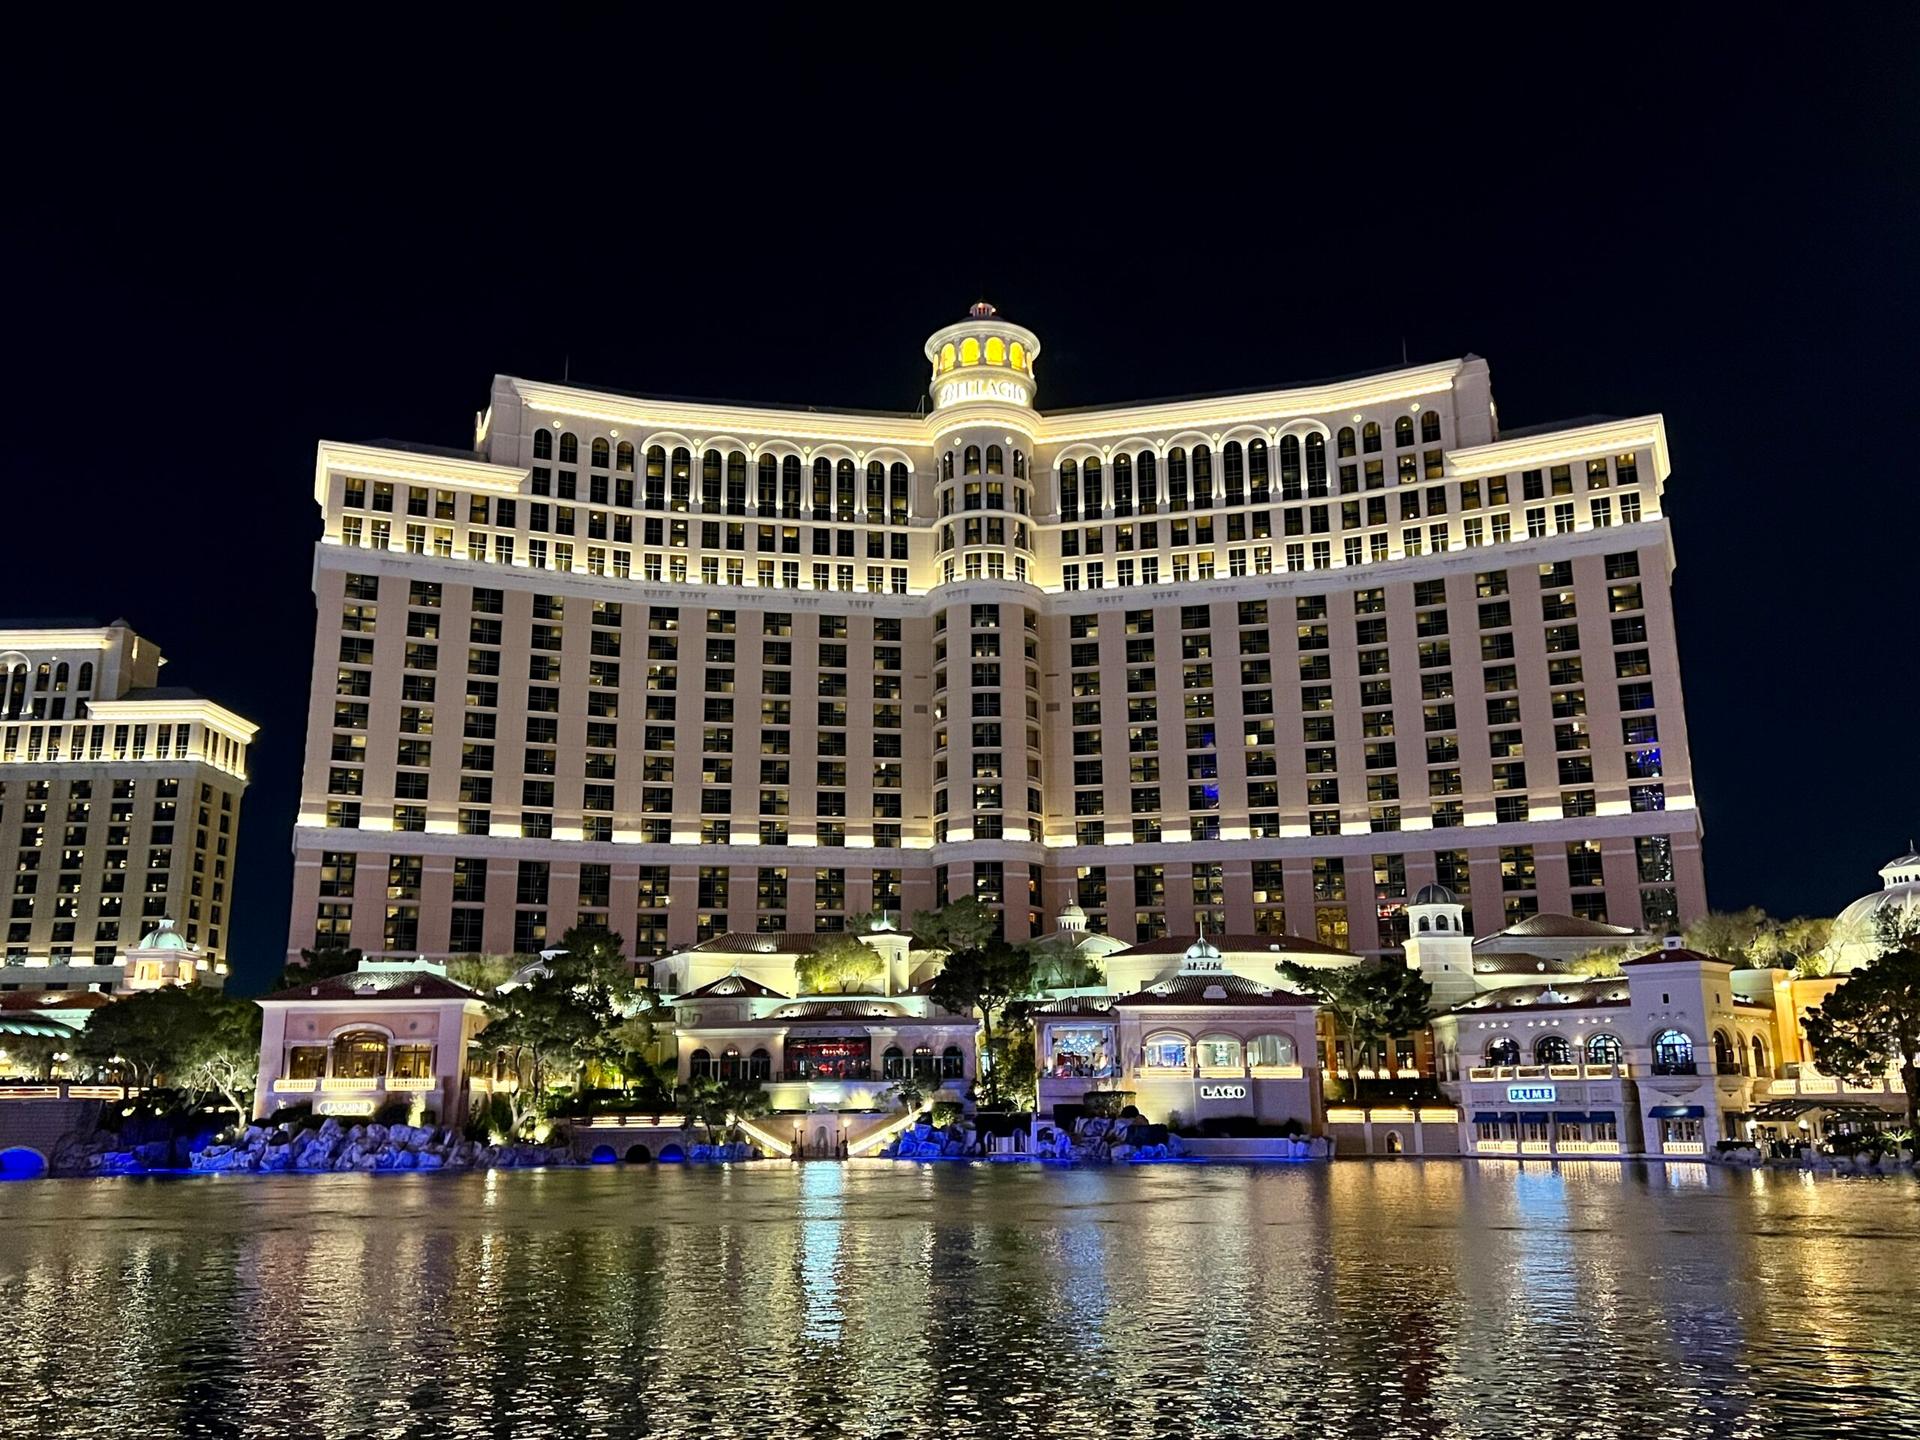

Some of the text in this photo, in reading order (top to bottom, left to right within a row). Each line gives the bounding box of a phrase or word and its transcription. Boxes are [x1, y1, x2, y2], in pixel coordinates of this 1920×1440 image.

[1202, 1086, 1245, 1097] LAGO
[1510, 1088, 1551, 1100] PRIME
[323, 1102, 368, 1114] JASMINE
